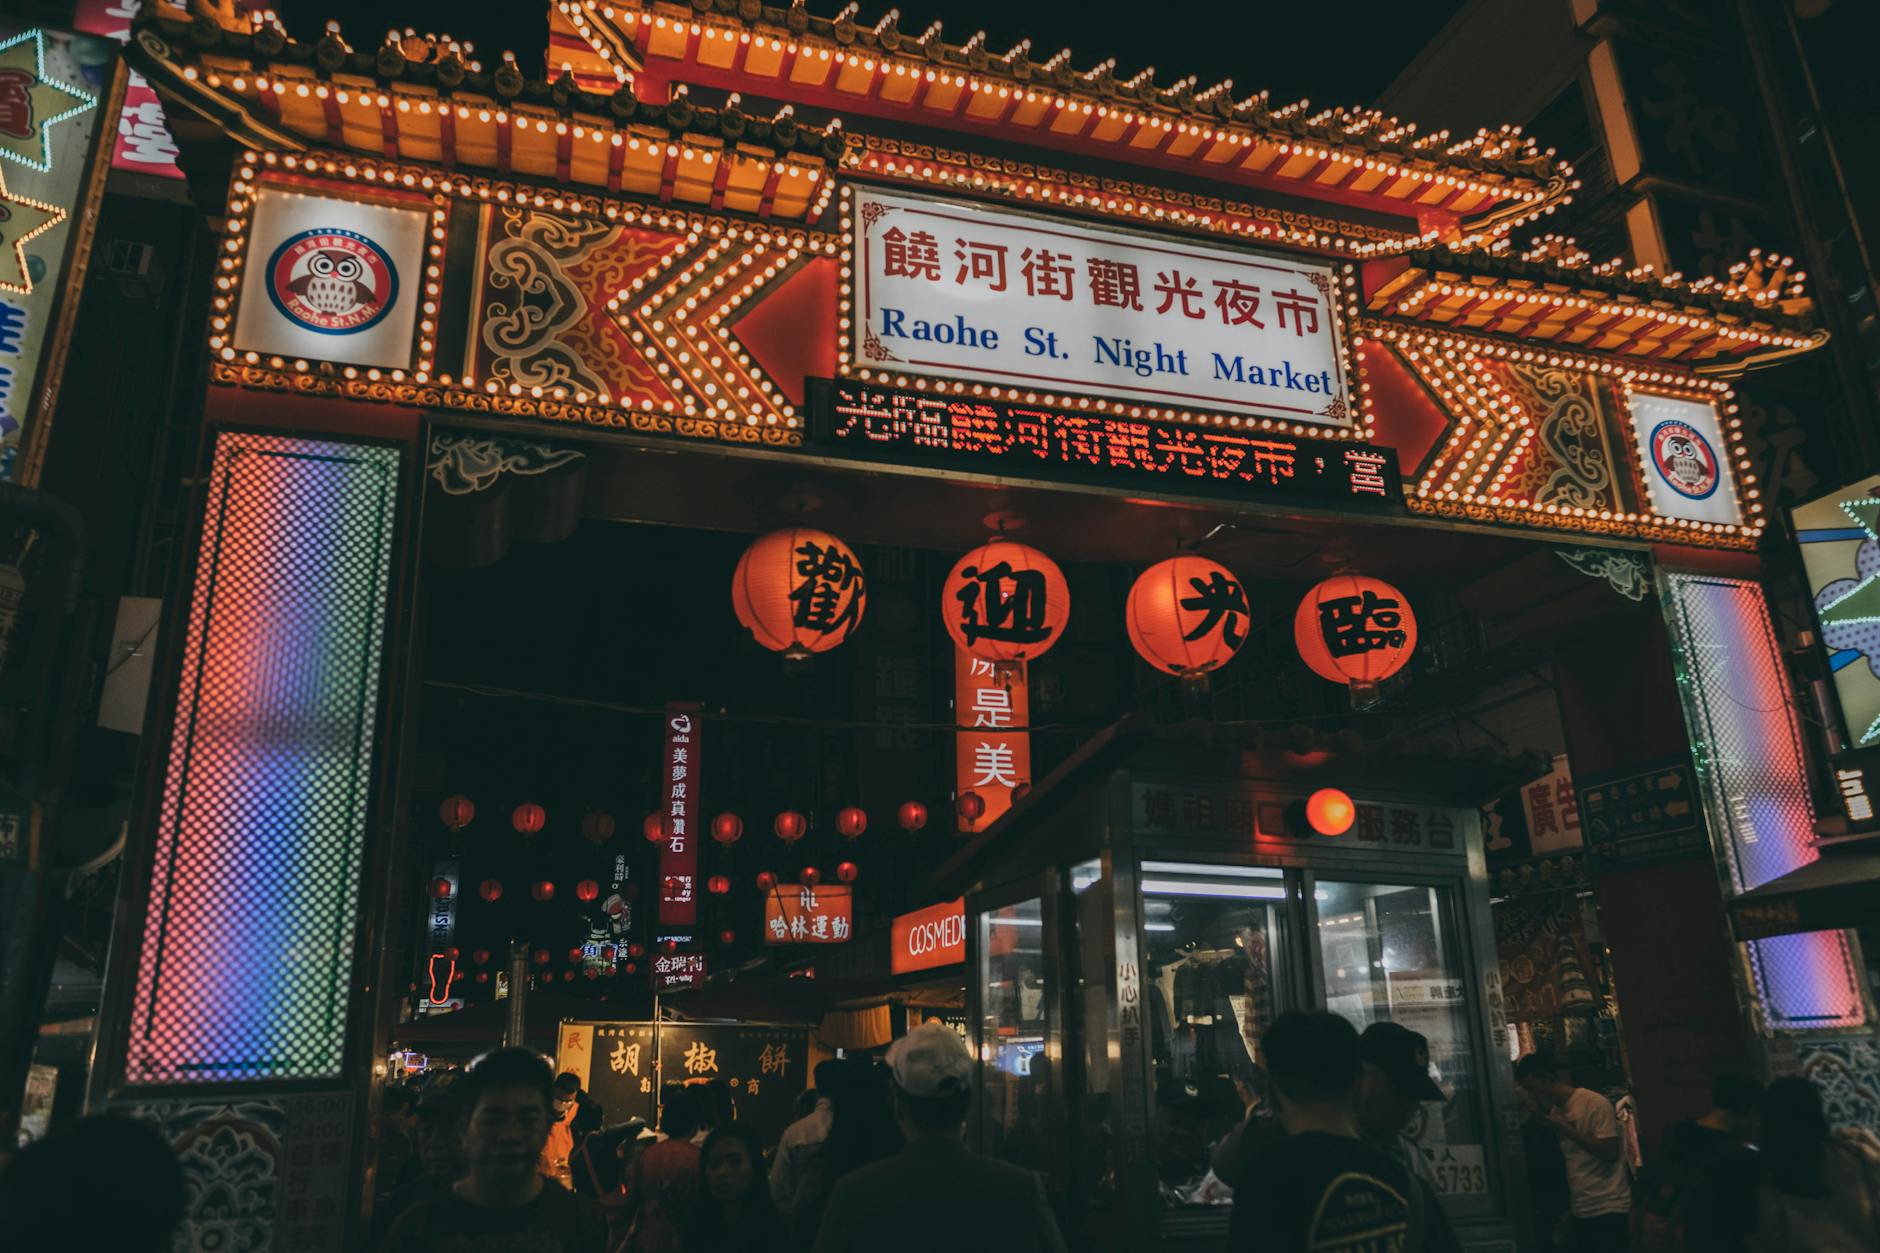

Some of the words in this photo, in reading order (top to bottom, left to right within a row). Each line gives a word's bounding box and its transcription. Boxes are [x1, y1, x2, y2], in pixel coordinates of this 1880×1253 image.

[287, 298, 328, 326] Raohe
[881, 225, 1320, 337] 饒河街觀光夜市
[880, 307, 999, 350] Raohe
[1024, 327, 1069, 360] St.
[1093, 335, 1188, 377] Night
[1213, 351, 1334, 396] Market
[957, 561, 1052, 647] 迎
[1180, 570, 1250, 650] 光
[1317, 590, 1406, 658] 臨
[672, 735, 690, 743] aida
[770, 915, 849, 940] 哈林運動
[1120, 963, 1139, 1046] 小心扒手
[609, 1040, 792, 1079] 胡椒餅
